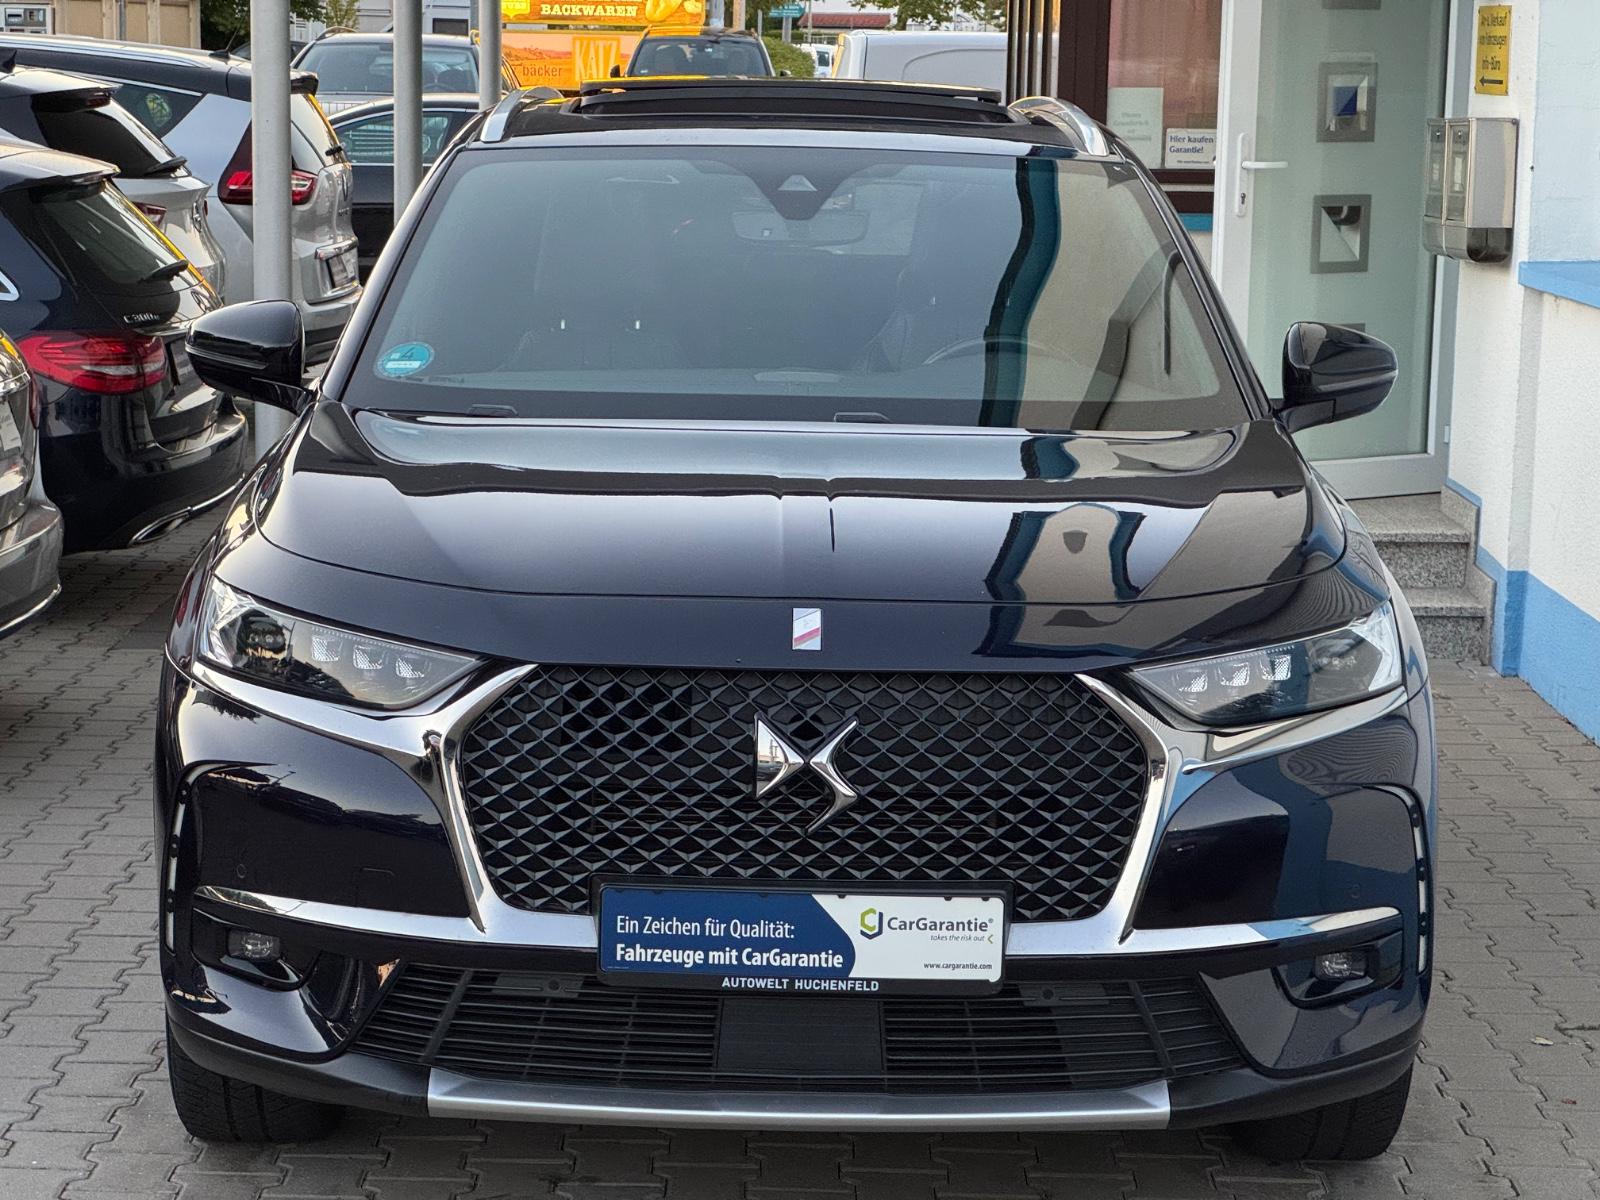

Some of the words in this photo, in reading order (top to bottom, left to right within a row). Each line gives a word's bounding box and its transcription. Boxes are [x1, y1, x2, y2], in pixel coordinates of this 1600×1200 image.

[541, 4, 637, 16] BACKWAREN
[574, 39, 619, 82] KATZ
[522, 64, 562, 77] bäcker
[1169, 135, 1186, 143] Hier
[1187, 135, 1214, 144] kaufen
[1169, 146, 1204, 154] Garantie!
[401, 346, 416, 359] 4
[616, 915, 639, 934] Ein
[643, 916, 700, 936] Zeichen
[705, 918, 726, 937] für
[730, 919, 795, 939] Qualität:
[616, 944, 704, 968] Fahrzeuge
[708, 947, 738, 965] mit
[742, 948, 844, 968] CarGarantie
[924, 962, 992, 970] www.cargarantie.com
[722, 977, 789, 990] AUTOWELT
[794, 979, 880, 991] HUCHENFELD
